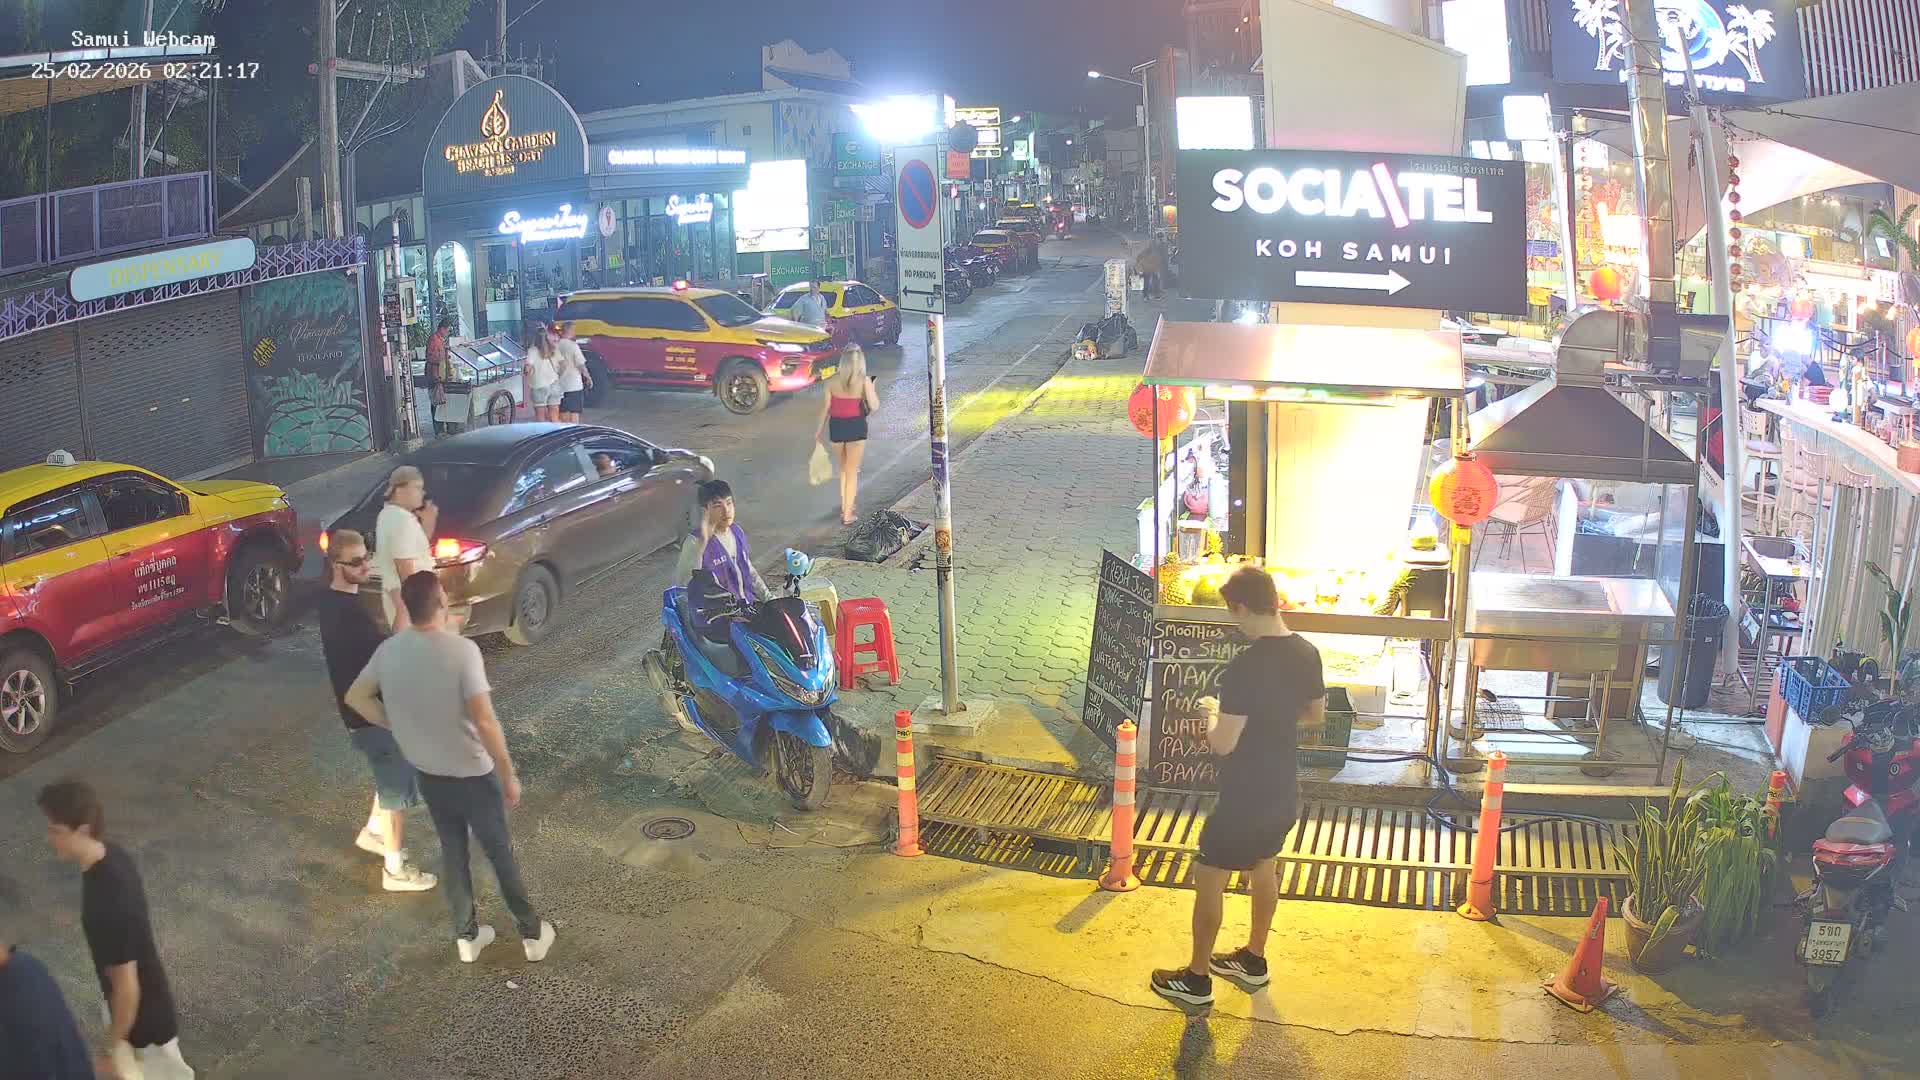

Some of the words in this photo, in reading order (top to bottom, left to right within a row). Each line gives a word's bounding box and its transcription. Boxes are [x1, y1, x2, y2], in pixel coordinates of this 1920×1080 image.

[837, 161, 878, 170] EXCHANGE
[1256, 239, 1323, 259] KOH
[1343, 242, 1451, 265] SAMUI
[109, 248, 222, 289] DISPENSARY
[771, 266, 809, 275] EXCHANGE
[904, 270, 912, 278] NO
[913, 270, 936, 280] PARKING
[1197, 641, 1252, 661] SHAK
[1811, 948, 1841, 961] 3957
